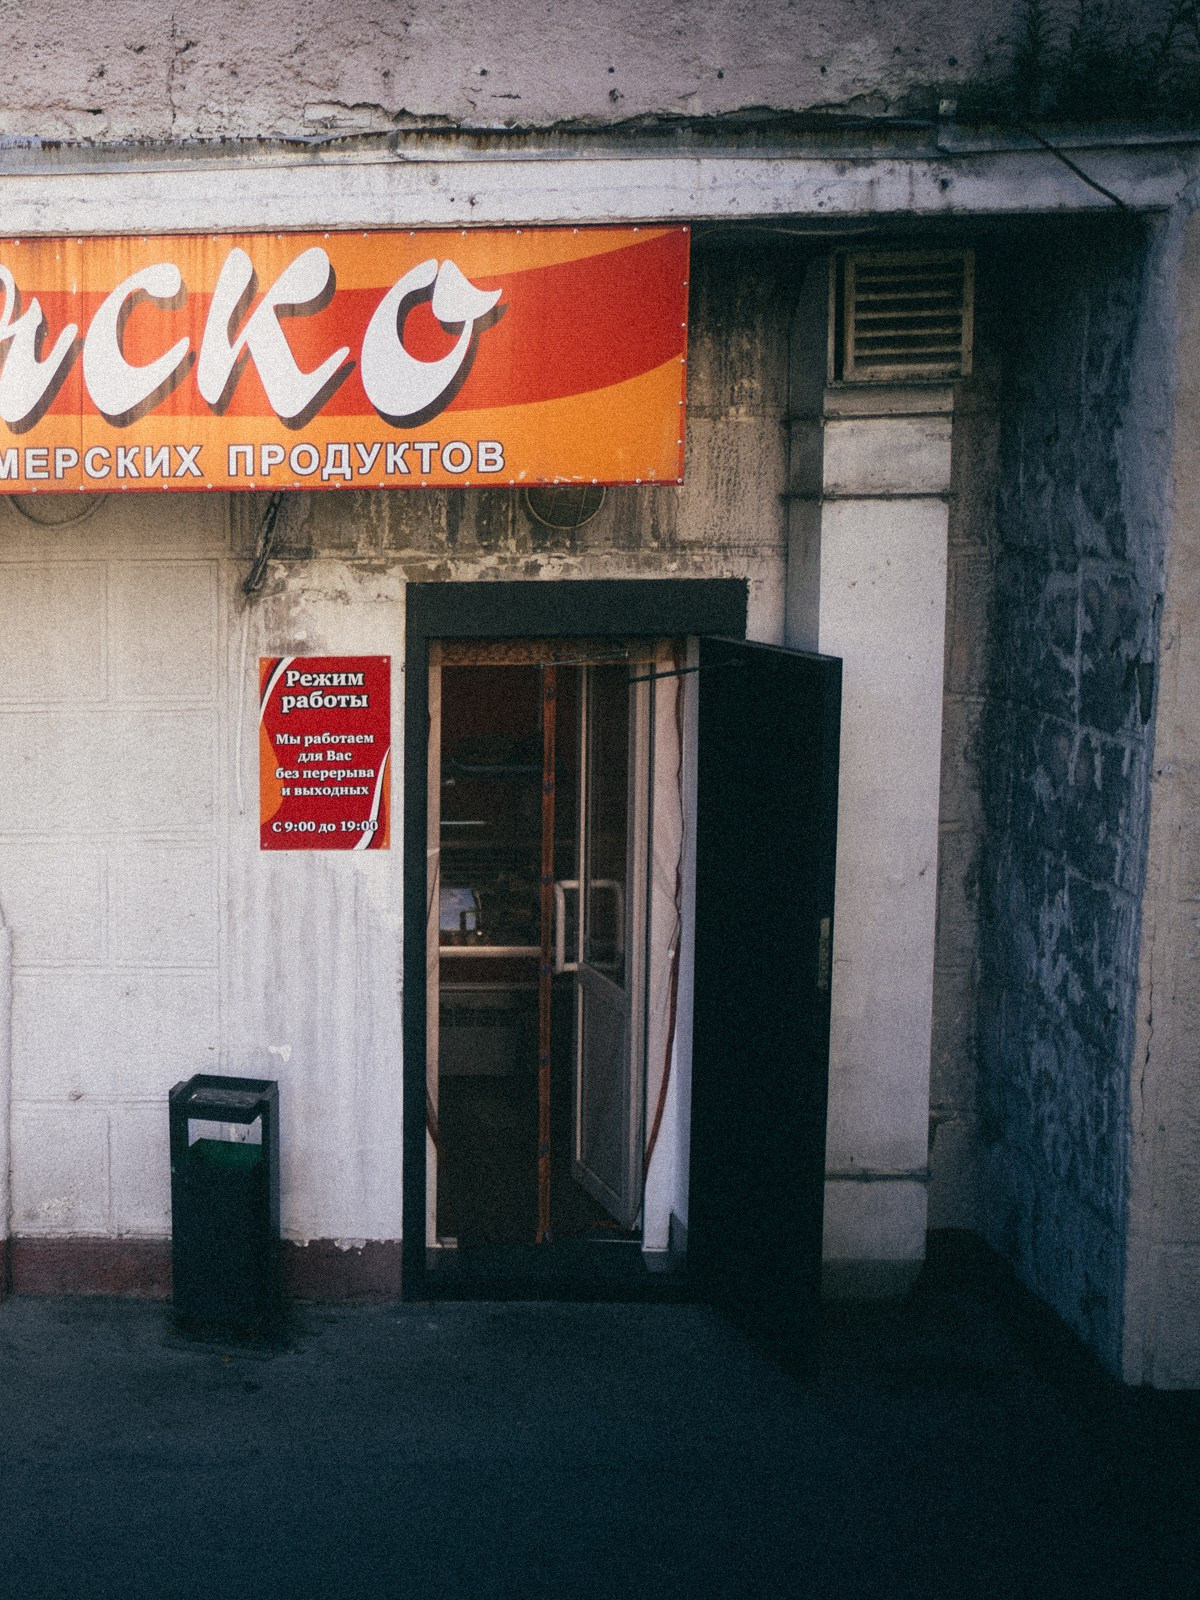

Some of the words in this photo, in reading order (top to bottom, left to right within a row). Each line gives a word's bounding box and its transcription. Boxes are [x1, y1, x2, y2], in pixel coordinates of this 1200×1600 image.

[227, 439, 506, 482] ПРОДУКТОВ
[285, 669, 365, 688] Режим
[281, 690, 369, 714] работы
[275, 733, 301, 746] Мы
[303, 732, 375, 748] работаем
[297, 750, 323, 763] для
[326, 749, 353, 762] Вас
[275, 766, 300, 779] без
[302, 768, 376, 783] перерыва
[281, 786, 292, 797] и
[294, 784, 370, 799] выходных
[284, 819, 316, 832] 9:00
[318, 821, 337, 834] до
[340, 818, 379, 833] 19:00
